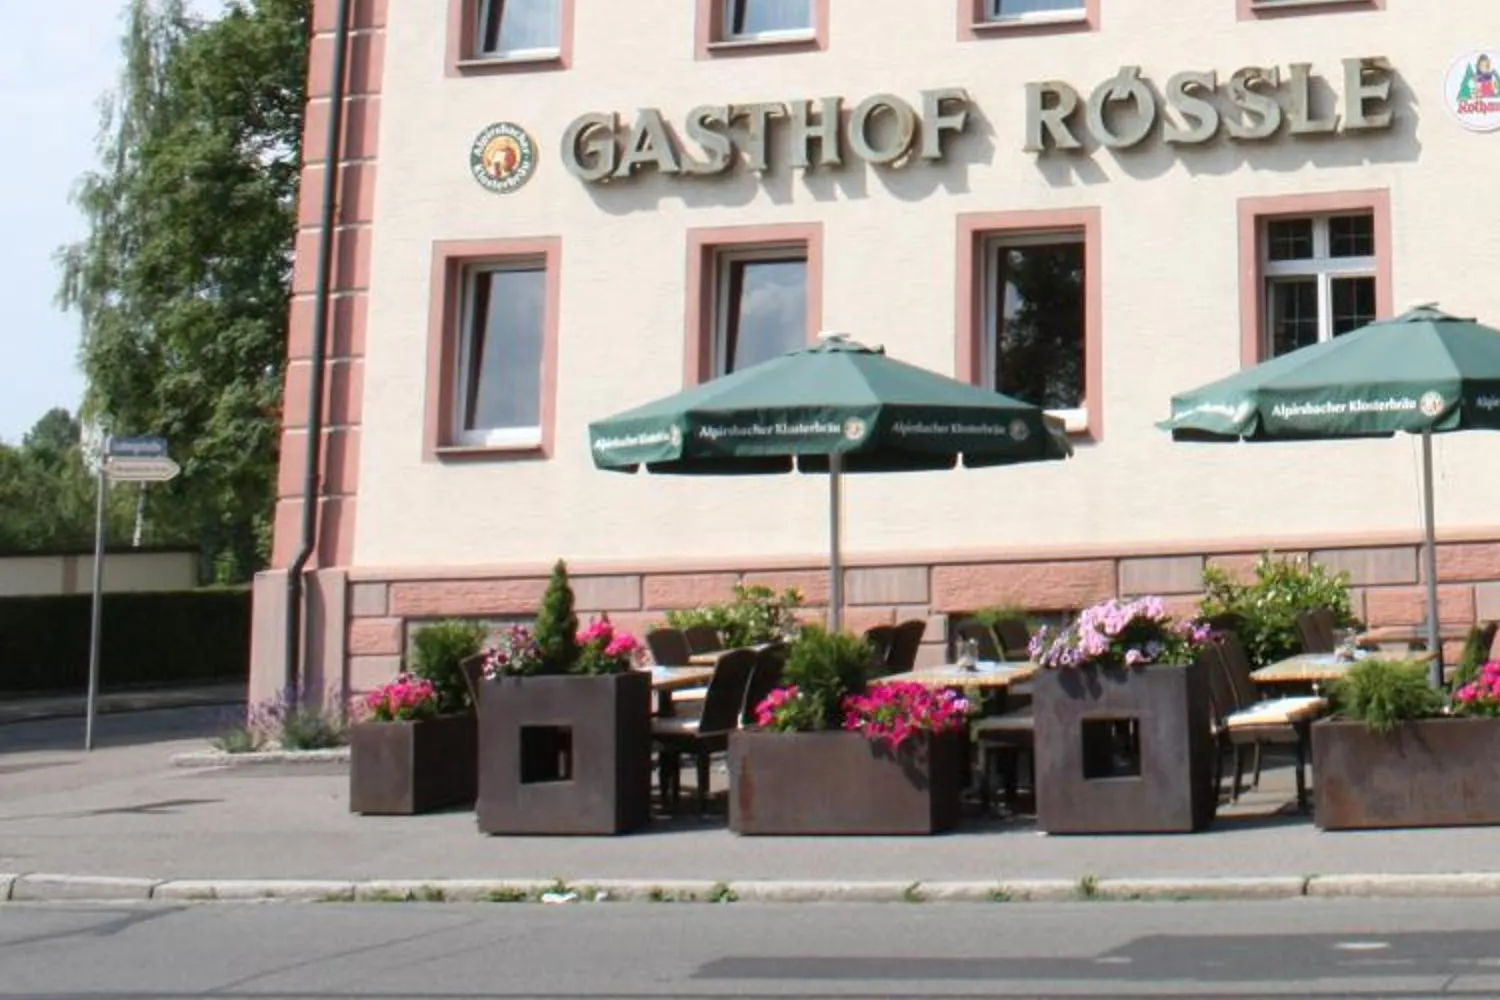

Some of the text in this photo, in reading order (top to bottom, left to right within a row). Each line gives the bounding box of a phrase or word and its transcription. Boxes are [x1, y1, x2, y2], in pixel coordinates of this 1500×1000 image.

[561, 56, 1394, 183] GASTHOF RÖSSLE
[1272, 397, 1417, 420] Alpirsbacher Klosterbräu
[699, 419, 841, 441] Alpirsbacher Klosterbräu
